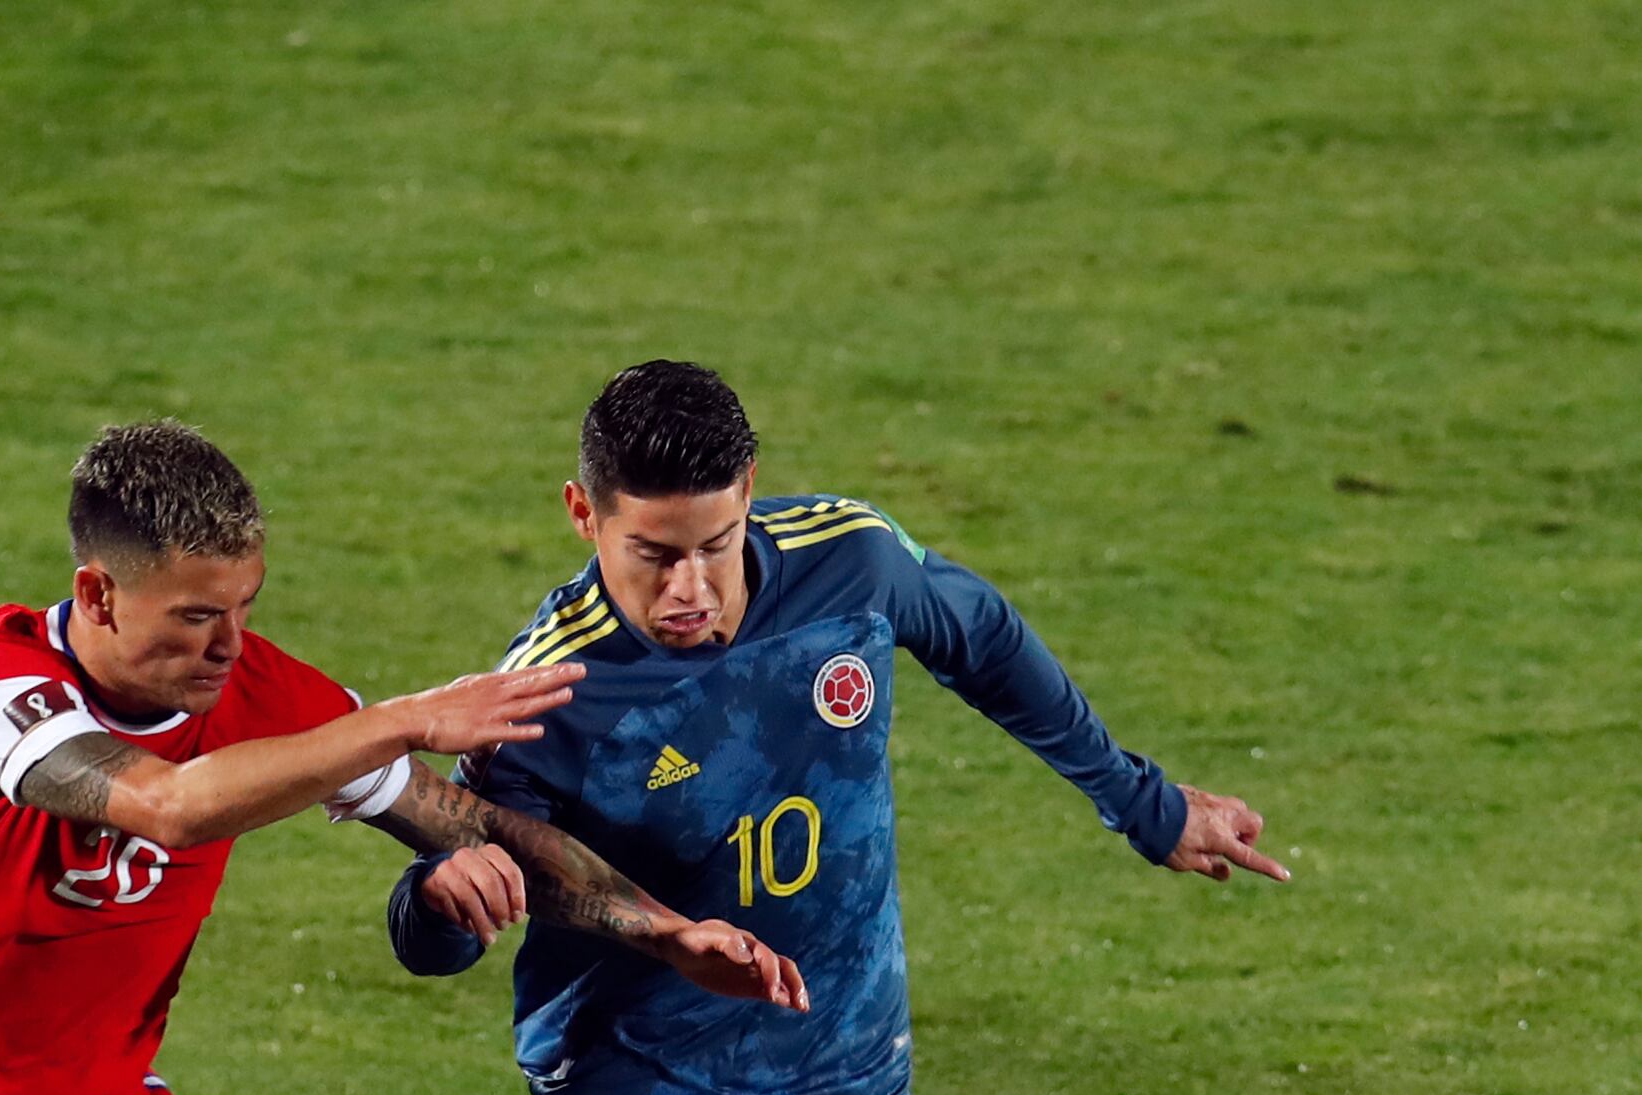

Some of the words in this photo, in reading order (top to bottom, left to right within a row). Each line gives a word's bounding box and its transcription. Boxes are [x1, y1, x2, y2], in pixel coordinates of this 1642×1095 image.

[647, 763, 700, 790] adidas
[52, 828, 170, 907] 20
[727, 796, 821, 906] 10
